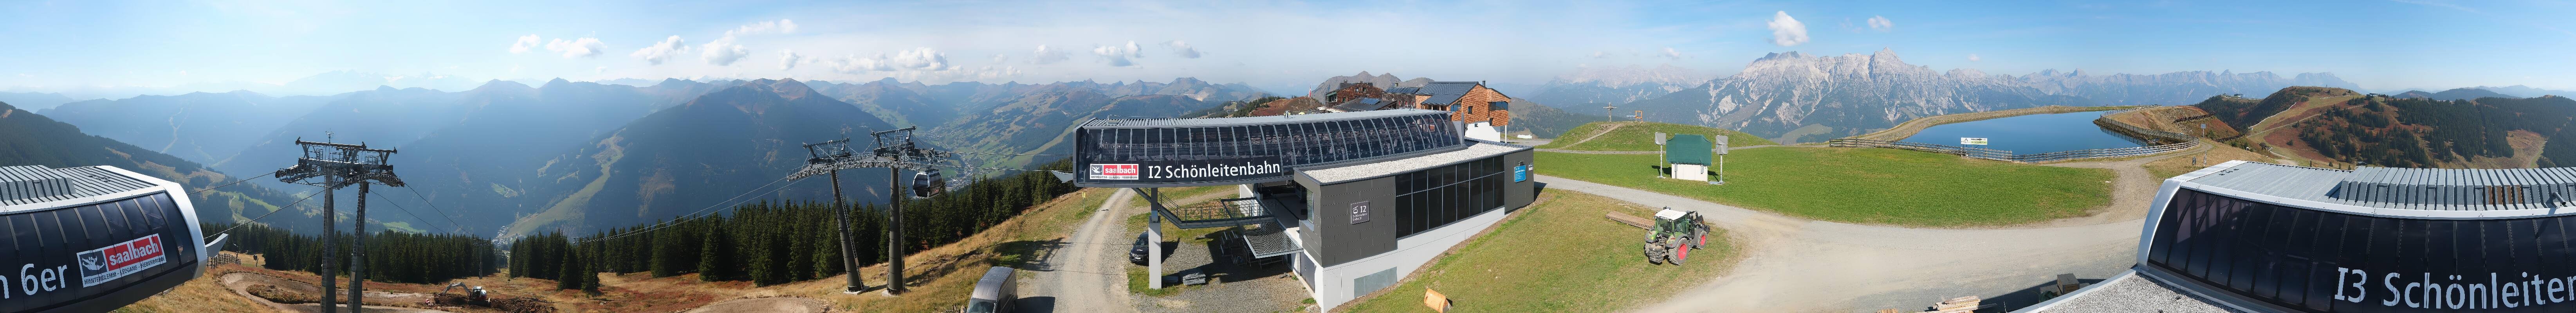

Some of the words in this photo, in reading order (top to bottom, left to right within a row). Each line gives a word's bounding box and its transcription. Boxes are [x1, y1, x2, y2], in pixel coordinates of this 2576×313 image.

[1105, 164, 1136, 173] saalbach
[1148, 165, 1161, 178] I2
[1165, 160, 1280, 178] Schönleitenbahn
[109, 237, 159, 266] saalbach
[21, 263, 67, 295] 6er
